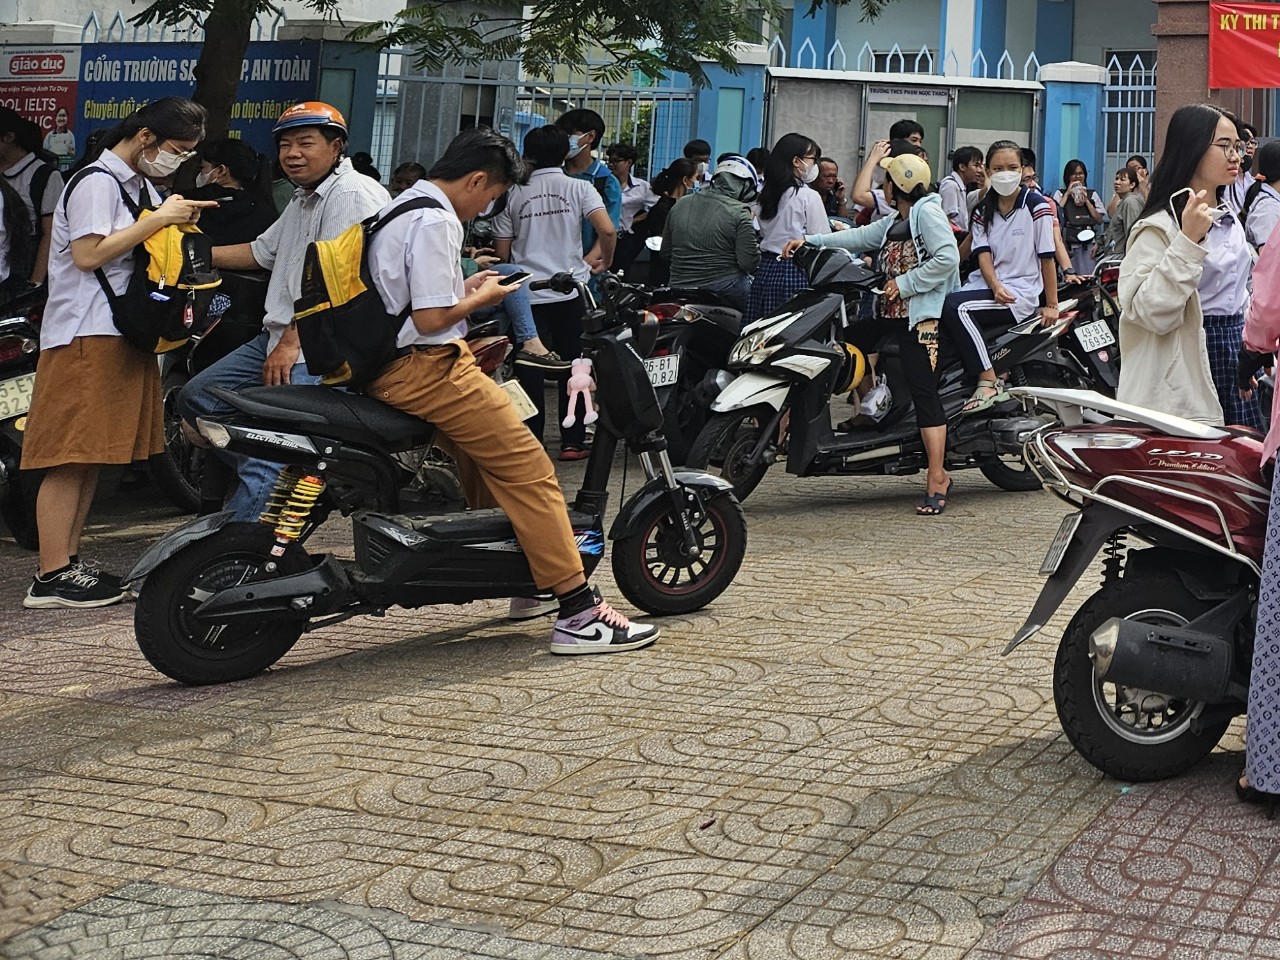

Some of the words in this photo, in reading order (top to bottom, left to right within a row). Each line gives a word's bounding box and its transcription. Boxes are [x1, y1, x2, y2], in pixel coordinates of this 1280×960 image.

[1220, 10, 1239, 30] KỲ
[1243, 14, 1267, 30] THI
[11, 57, 39, 73] giáo
[41, 57, 63, 73] dục
[84, 55, 120, 82] CỔNG
[123, 56, 176, 82] TRƯỜNG
[251, 59, 272, 81] AN
[273, 55, 311, 81] TOÀN
[25, 98, 57, 111] IELTS
[84, 96, 119, 120] Chuyển
[1081, 324, 1104, 338] 49-B1
[1083, 333, 1113, 350] 769.55
[245, 433, 281, 445] ELECTRIC
[1147, 448, 1224, 460] LEAD
[1157, 459, 1190, 469] Premium
[1191, 460, 1217, 471] Edition
